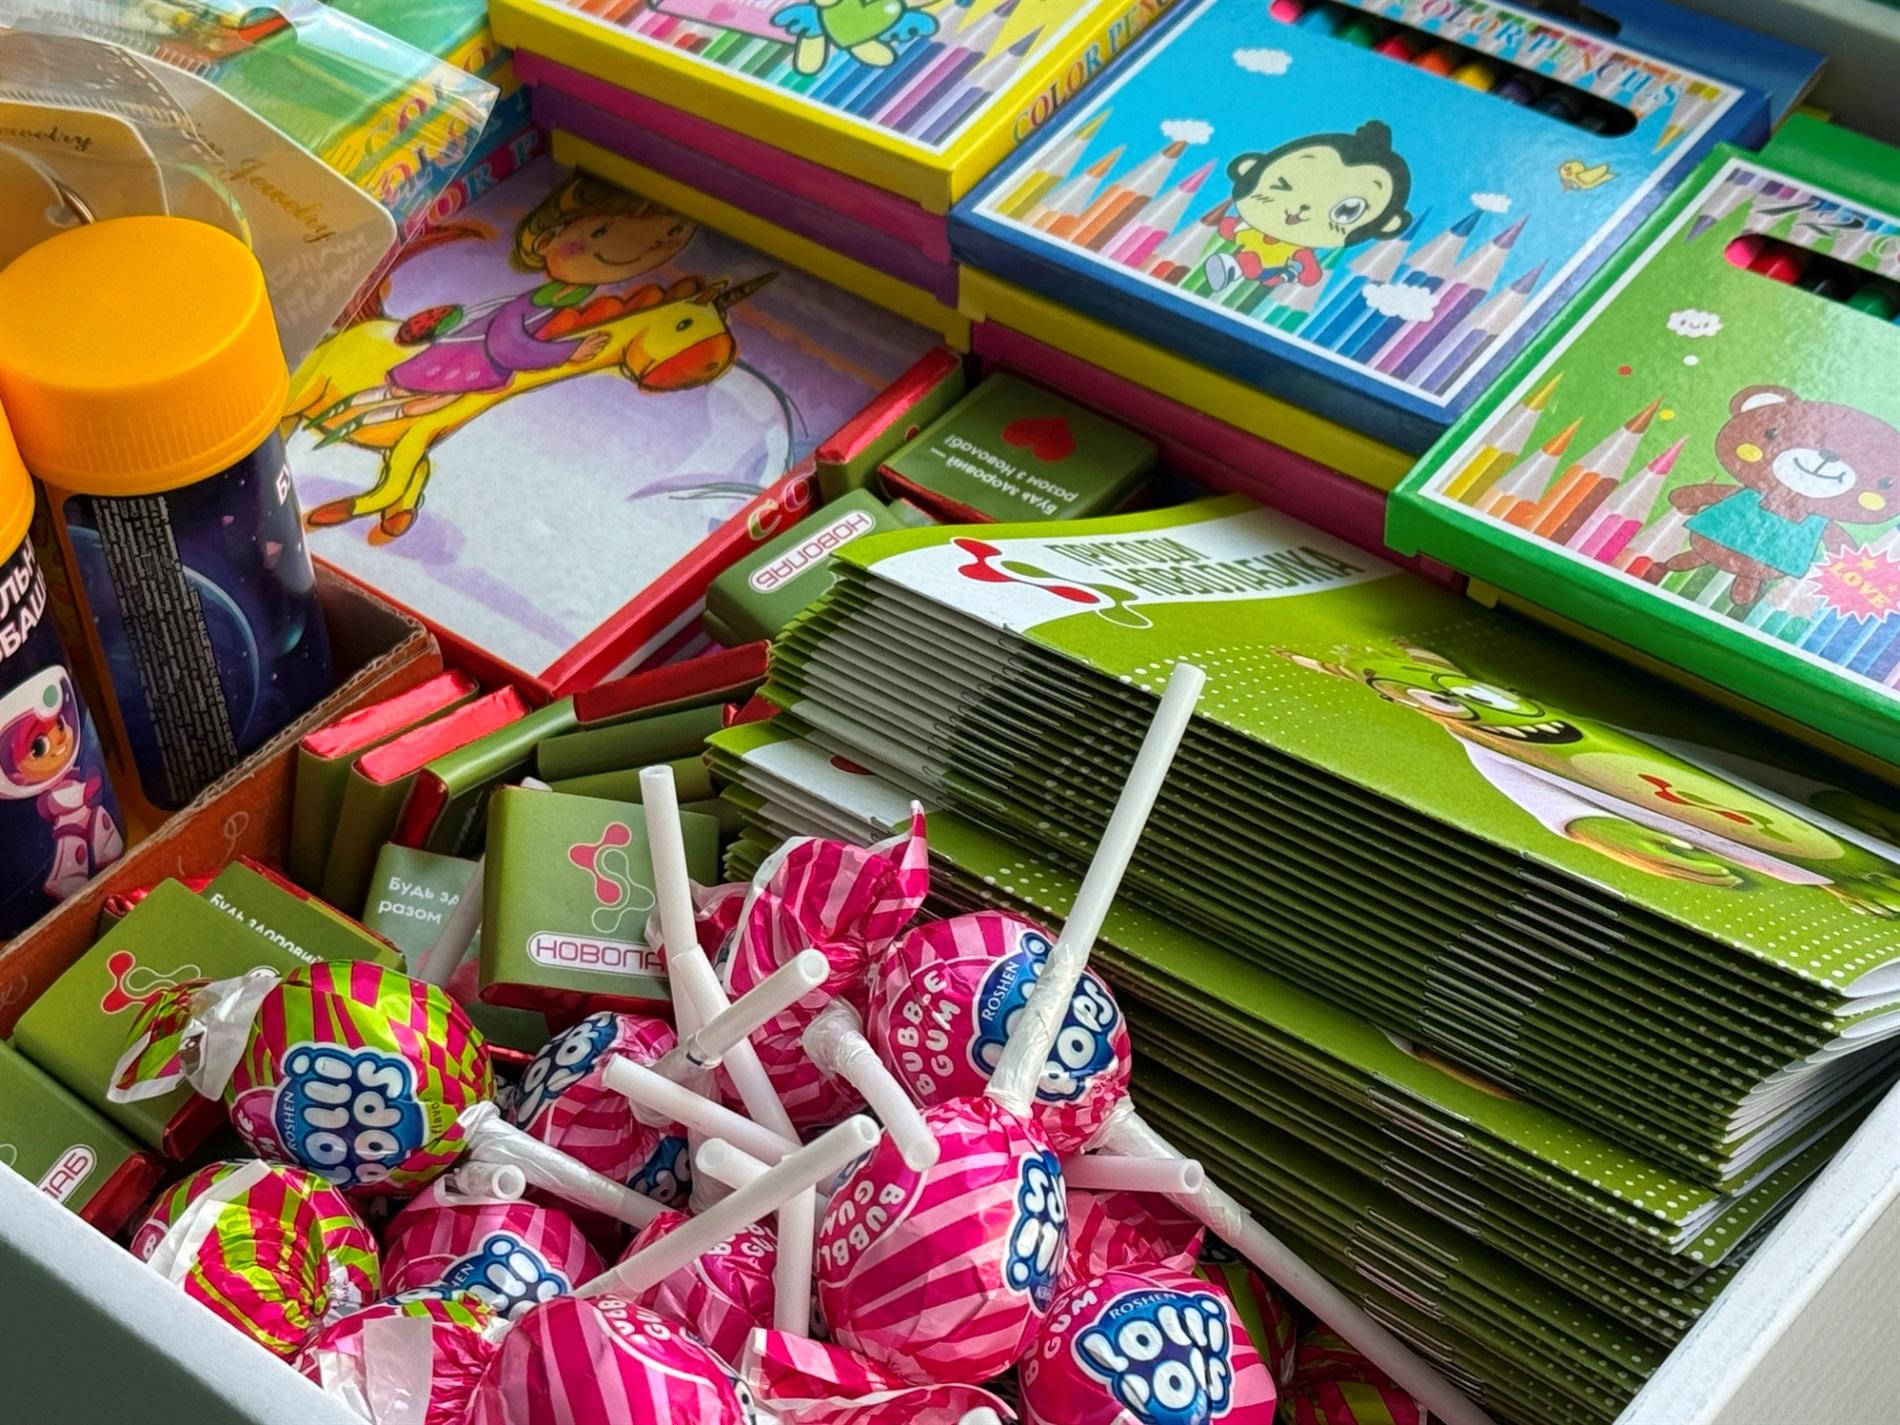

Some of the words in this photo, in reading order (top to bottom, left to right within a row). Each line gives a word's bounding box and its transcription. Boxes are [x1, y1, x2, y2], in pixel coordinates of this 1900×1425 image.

[1012, 42, 1104, 145] COLOR
[946, 455, 1021, 497] здоровий
[1025, 474, 1080, 504] разом
[1021, 491, 1059, 516] Будь
[756, 513, 870, 589] НОВОЛАБ
[1829, 562, 1892, 610] LOVE
[378, 899, 442, 926] разом
[388, 876, 435, 902] Будь
[981, 961, 1021, 1023] ROSHEN
[925, 999, 962, 1078] GUM
[283, 1090, 299, 1152] ROSHEN
[1043, 1290, 1098, 1360] GUM
[1108, 1293, 1178, 1321] ROSHEN
